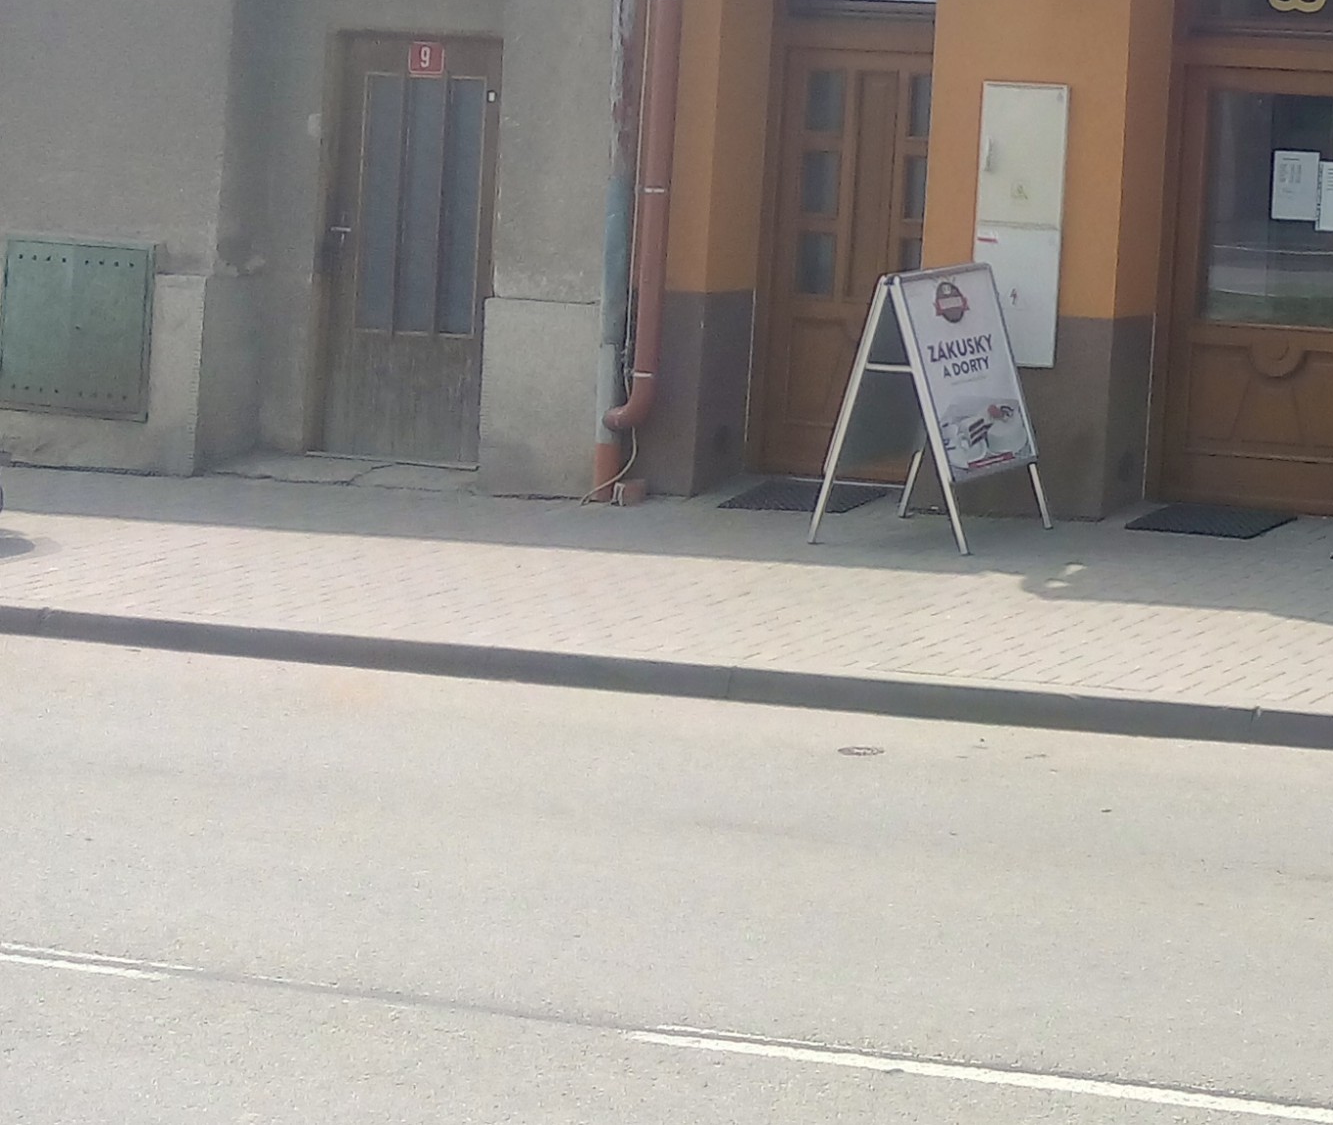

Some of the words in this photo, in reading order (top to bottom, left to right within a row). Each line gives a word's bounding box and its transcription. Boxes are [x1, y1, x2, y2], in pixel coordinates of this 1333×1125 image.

[420, 46, 431, 68] 9
[927, 334, 993, 363] ZÁKUSKY
[943, 365, 952, 378] A
[952, 356, 990, 376] DORTY
